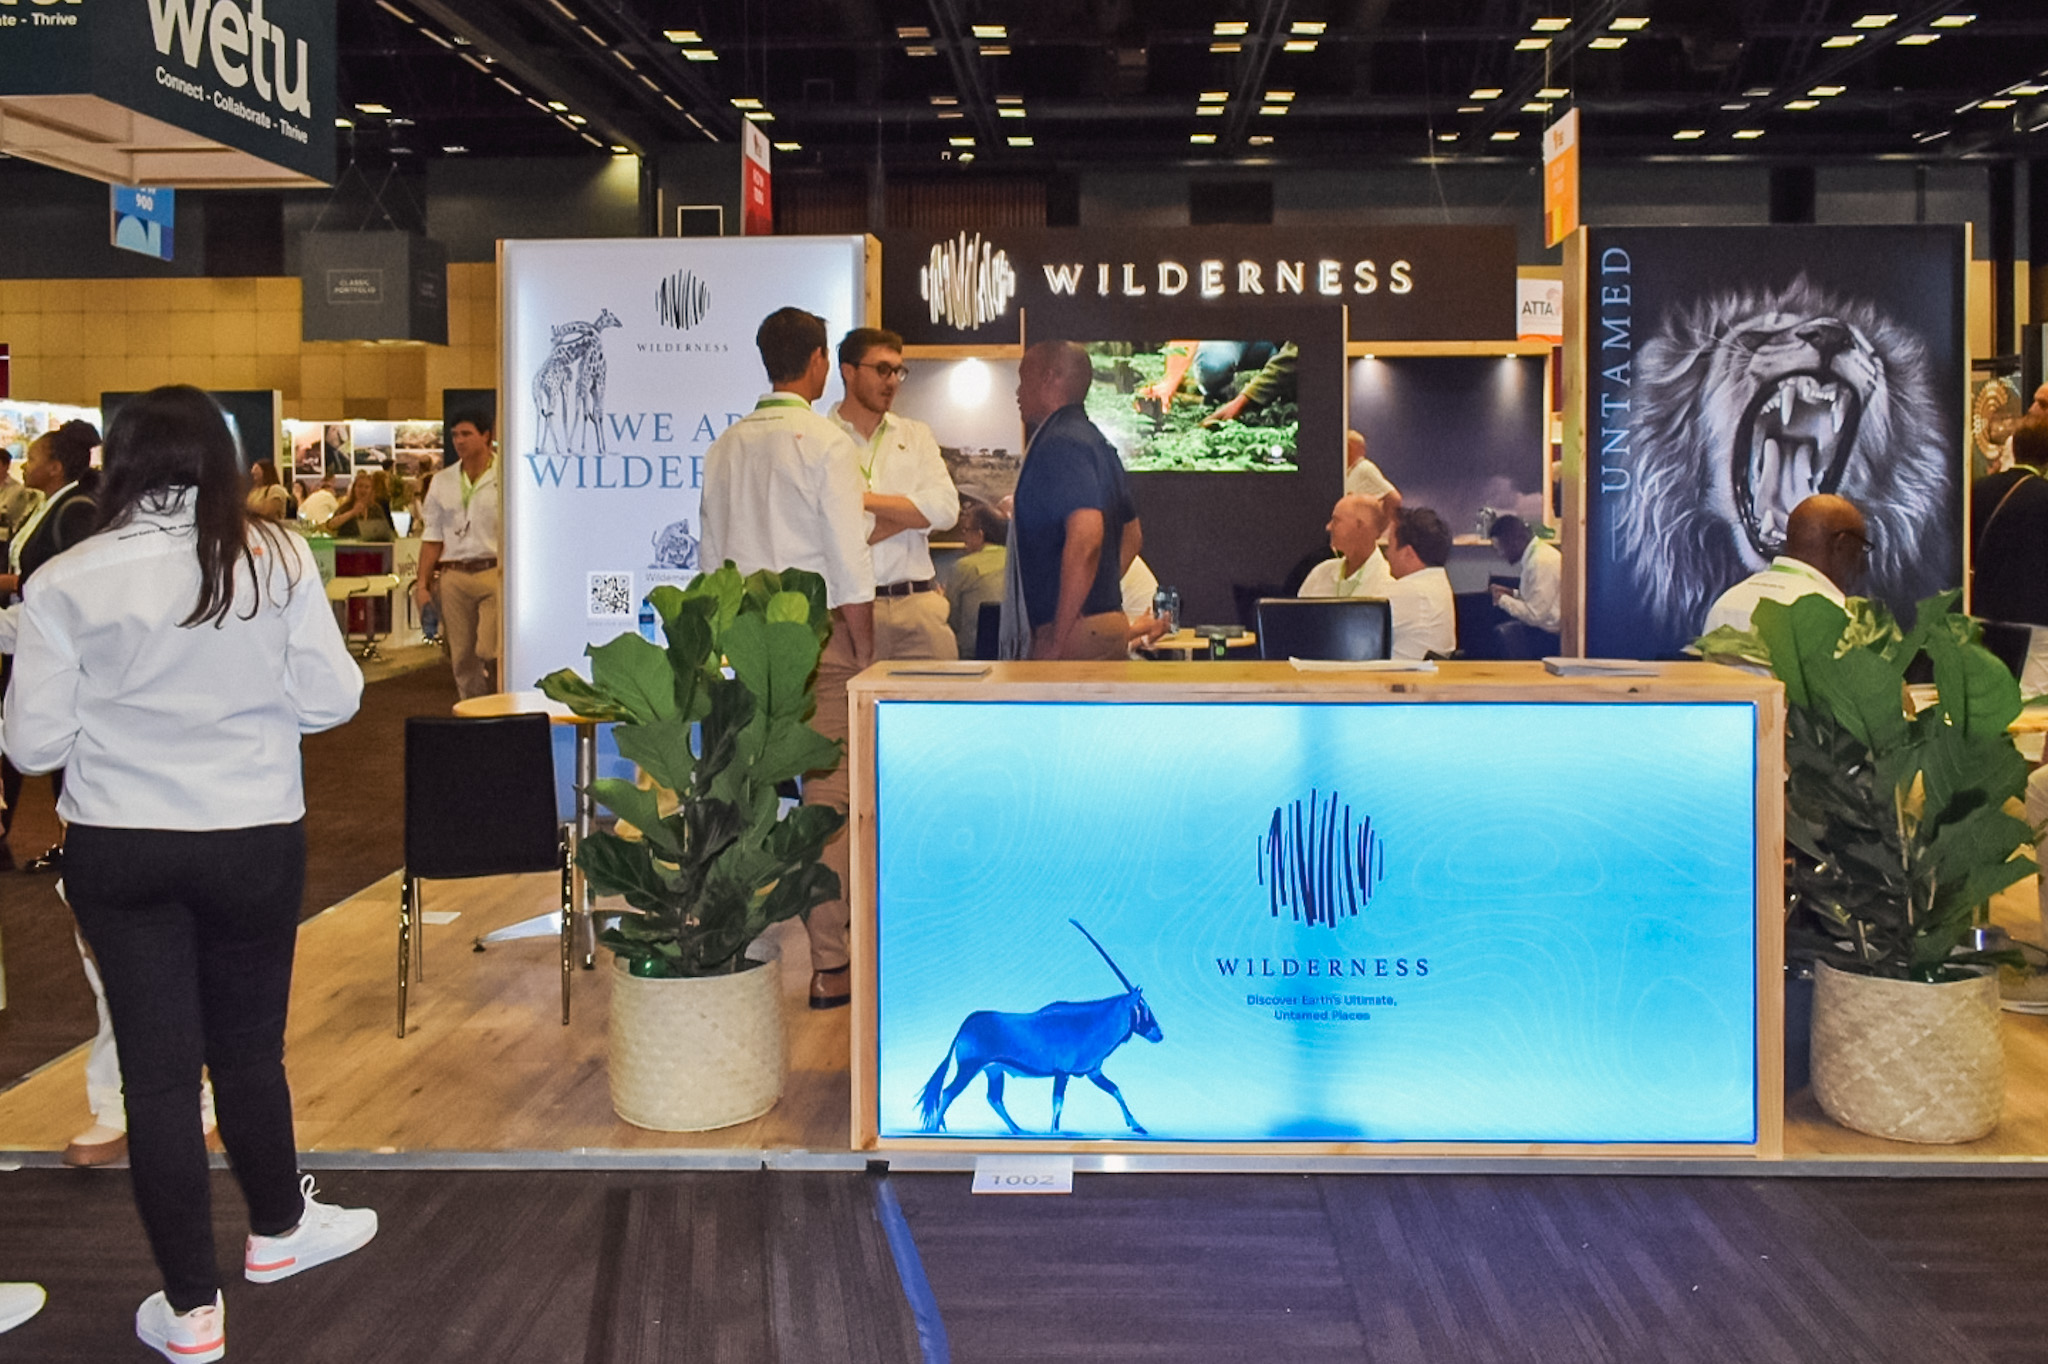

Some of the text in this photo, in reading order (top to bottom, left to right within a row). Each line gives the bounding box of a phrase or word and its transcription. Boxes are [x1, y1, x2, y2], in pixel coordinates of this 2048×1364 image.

[31, 12, 77, 25] Thrive
[147, 0, 311, 118] wetu
[156, 66, 204, 101] Connect
[214, 91, 271, 129] Collaborate
[279, 118, 308, 144] Thrive
[1042, 260, 1414, 297] WILDERNESS
[1522, 300, 1553, 316] ATTA
[637, 343, 728, 353] WILDERNESS
[1601, 247, 1631, 494] UNTAMED
[607, 413, 674, 442] WE
[1216, 958, 1430, 977] WILDERNESS
[1247, 994, 1398, 1007] Discover Earth's Ultimate,
[1274, 1010, 1371, 1020] Untamed Places
[992, 1174, 1055, 1186] 1002
